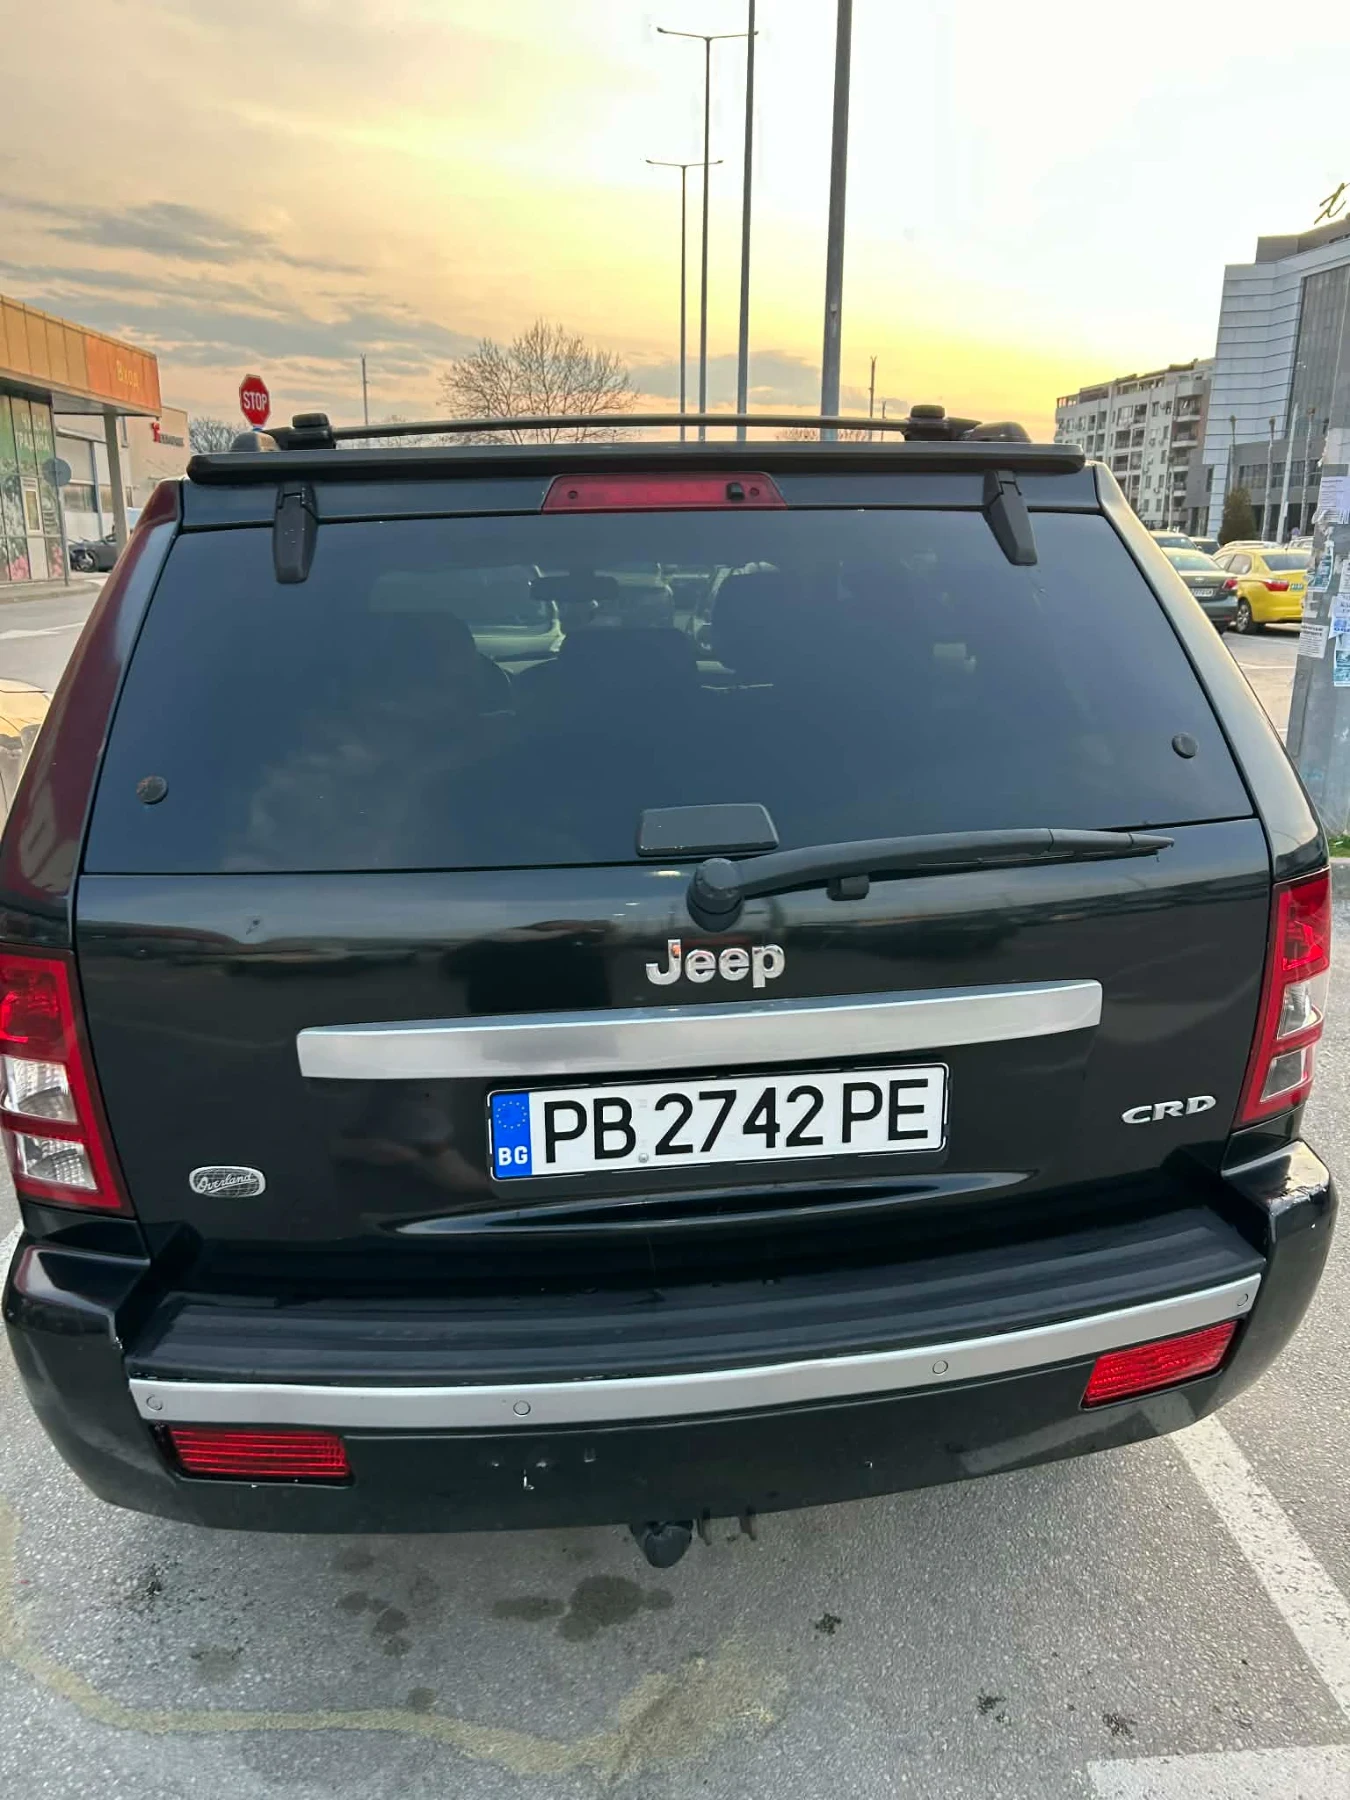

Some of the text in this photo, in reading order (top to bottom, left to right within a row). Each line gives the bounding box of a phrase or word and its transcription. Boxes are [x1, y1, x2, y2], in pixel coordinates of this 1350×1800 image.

[243, 391, 267, 411] STOP
[646, 939, 785, 987] Jeep
[544, 1079, 929, 1163] PB 2742 PE
[1122, 1095, 1216, 1124] CRD
[498, 1146, 528, 1166] BG
[197, 1172, 257, 1194] Overland
